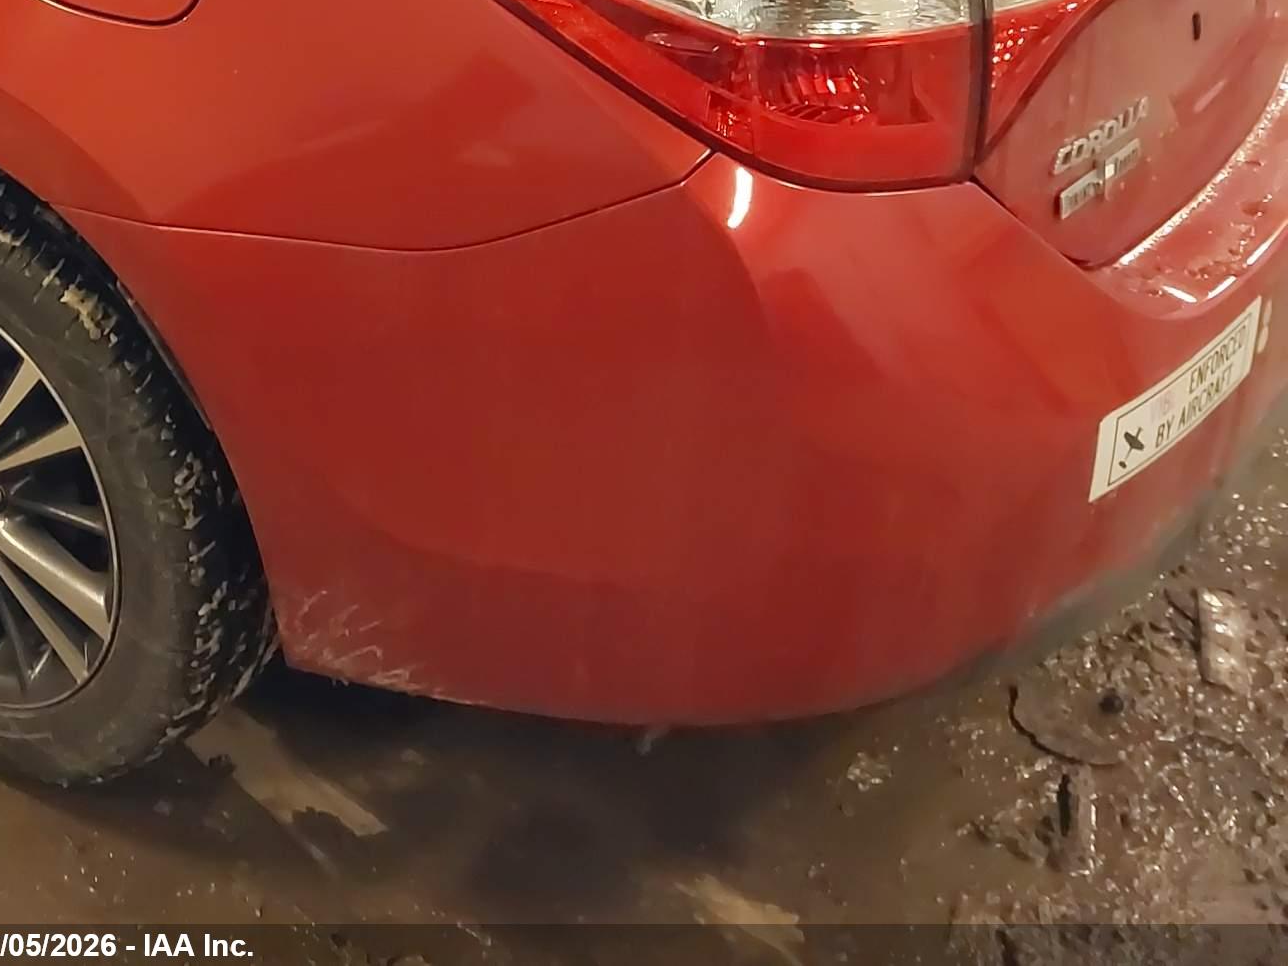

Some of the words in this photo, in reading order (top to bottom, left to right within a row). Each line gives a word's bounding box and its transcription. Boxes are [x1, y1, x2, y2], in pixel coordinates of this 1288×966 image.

[1054, 96, 1149, 175] COROLLA
[1155, 414, 1175, 448] BY
[1177, 362, 1234, 430] AIRCRAFT
